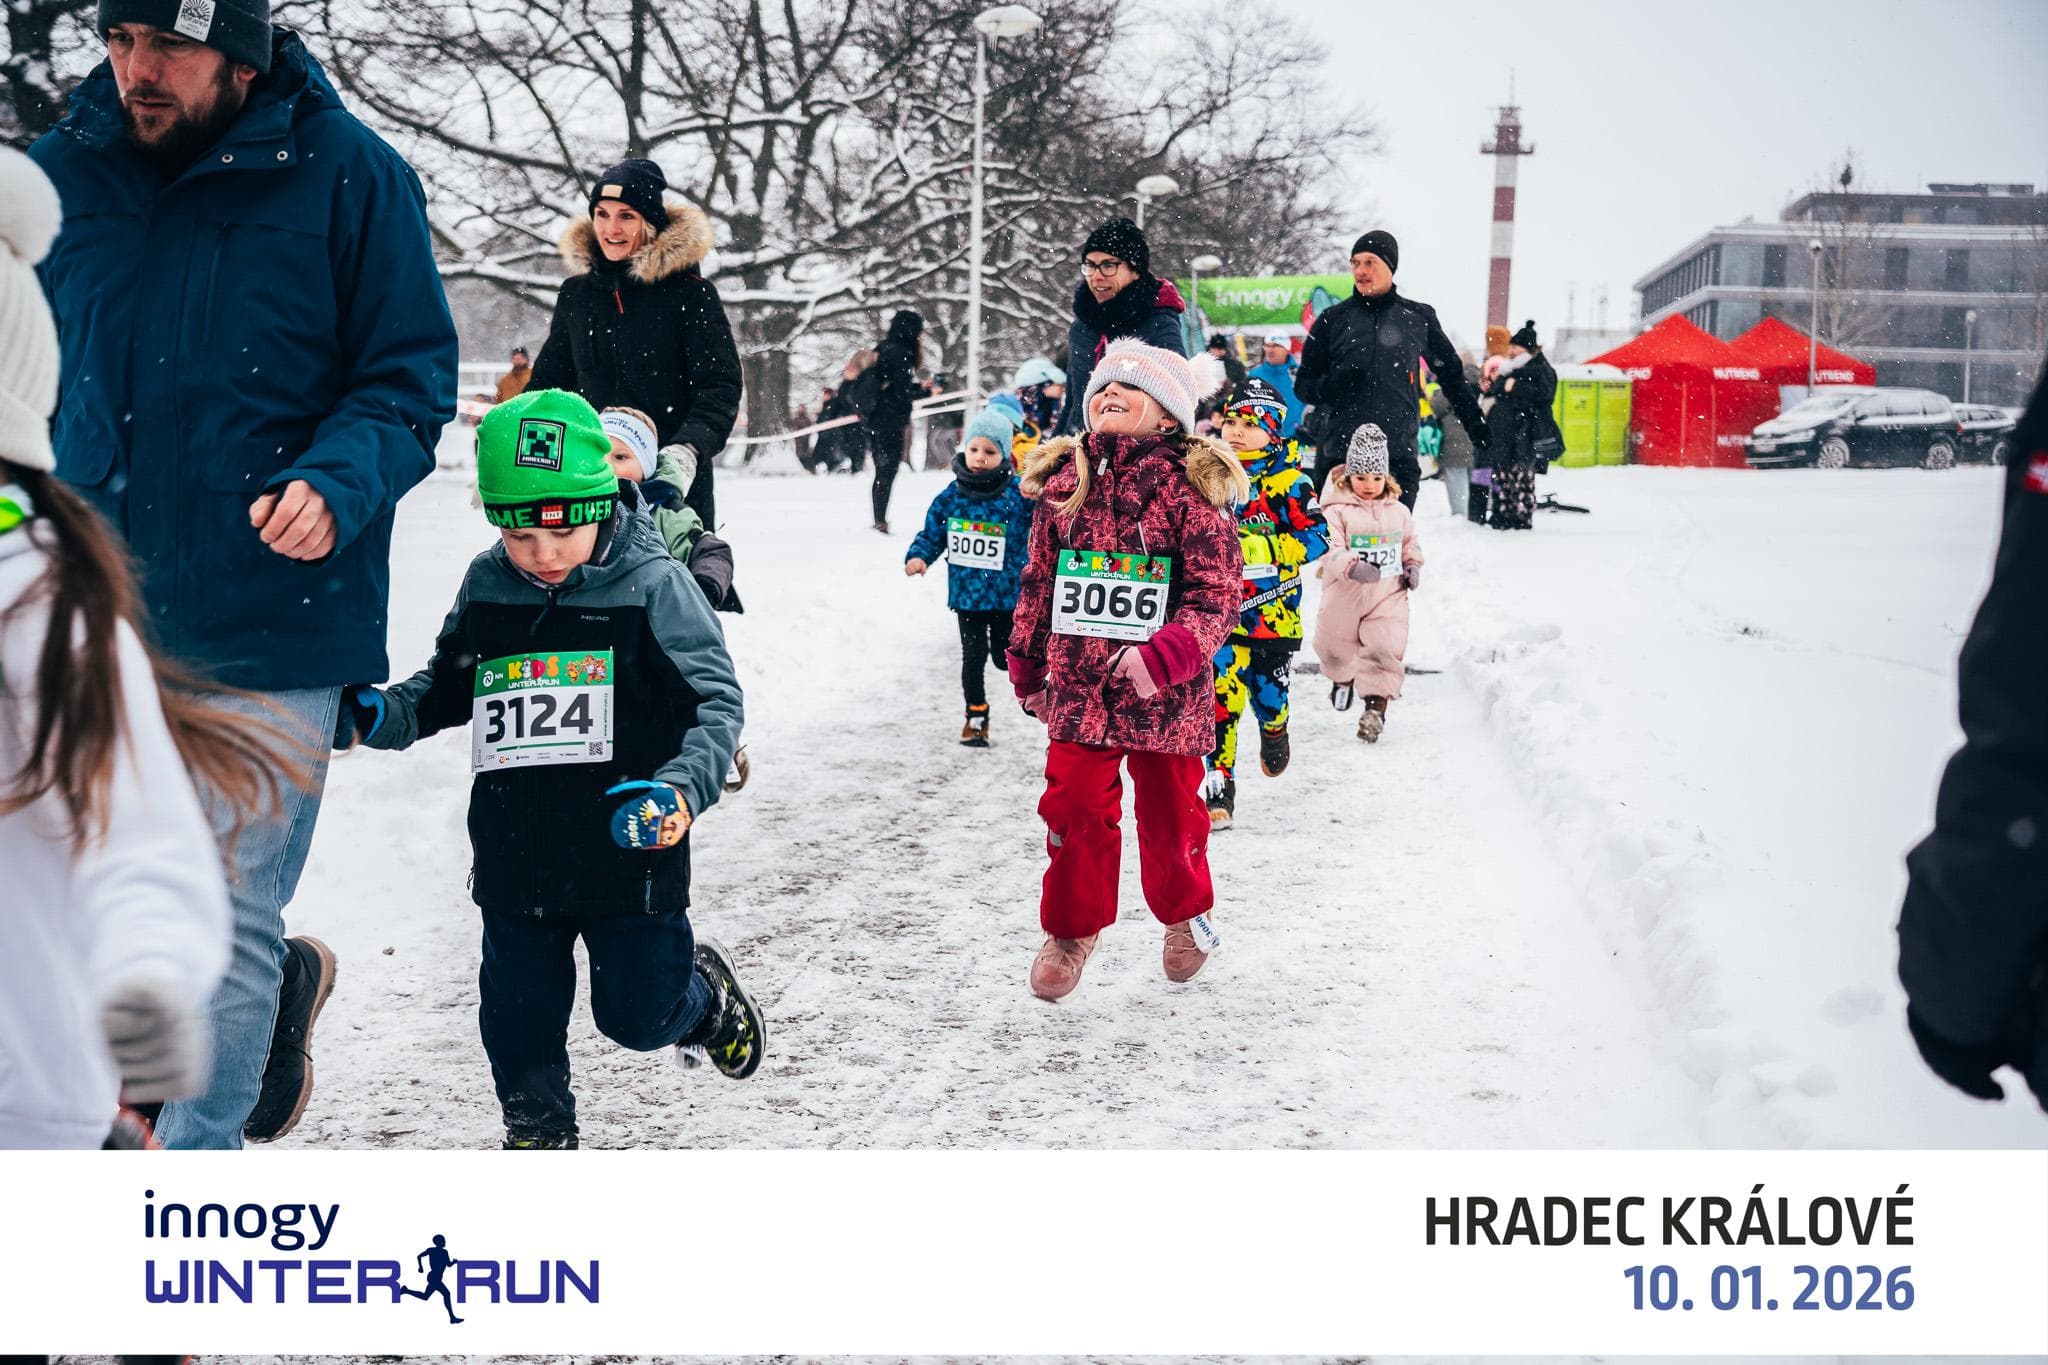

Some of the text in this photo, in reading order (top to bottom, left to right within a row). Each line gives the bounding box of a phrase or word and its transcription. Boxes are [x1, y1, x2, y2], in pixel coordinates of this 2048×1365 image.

[1216, 286, 1293, 310] innogy
[1815, 370, 1855, 382] UTREND
[521, 456, 556, 465] MINECRAFT
[486, 508, 534, 528] AME
[569, 500, 611, 525] OVER
[952, 535, 999, 557] 3005
[1358, 548, 1396, 567] 3129
[1060, 581, 1158, 620] 3066
[508, 656, 559, 680] KIDS
[485, 693, 594, 744] 3124
